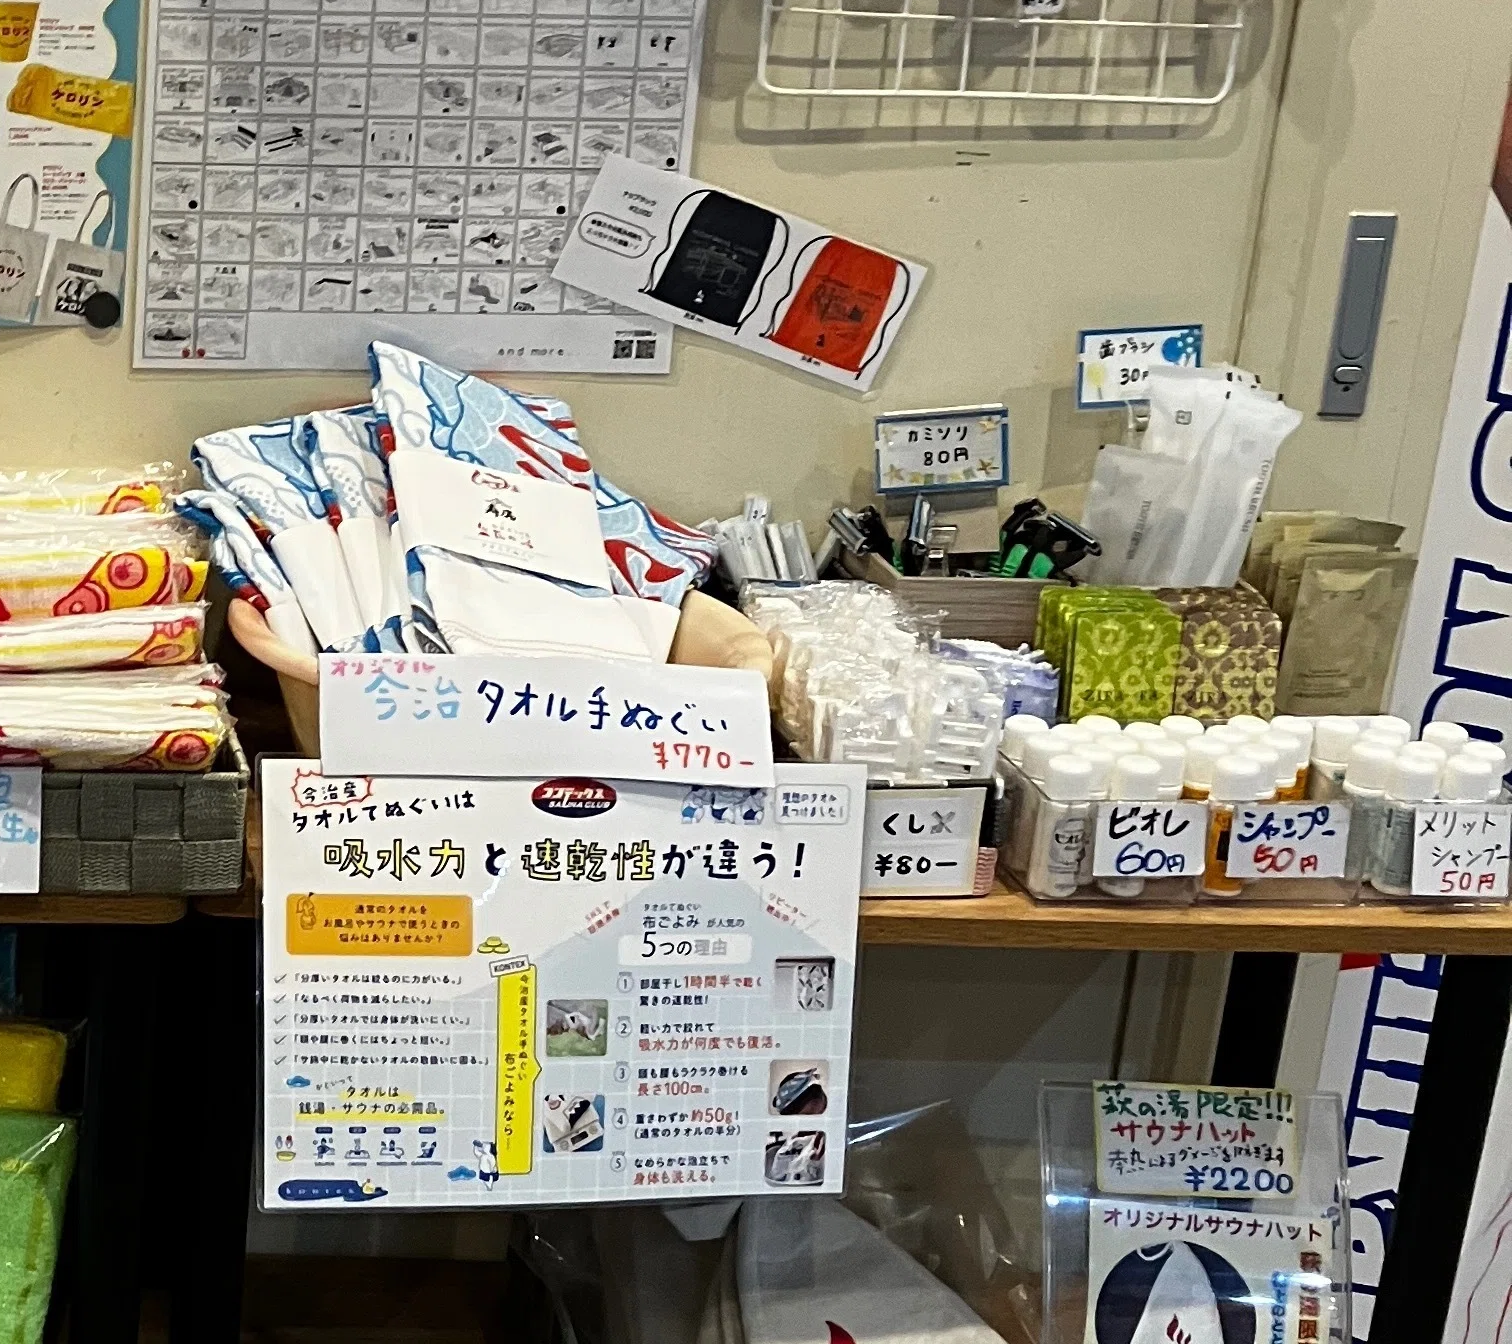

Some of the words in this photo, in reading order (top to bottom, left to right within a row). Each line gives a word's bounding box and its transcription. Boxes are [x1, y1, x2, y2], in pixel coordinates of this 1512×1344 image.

[907, 424, 970, 445] カミソリ
[923, 447, 970, 467] 80円
[329, 659, 437, 676] オリジナル
[364, 672, 462, 724] 今治
[477, 677, 729, 737] タオル手ぬぐい
[301, 780, 361, 804] 今治産
[291, 789, 477, 834] タオルてぬぐいは
[882, 812, 926, 838] くし
[1107, 805, 1191, 840] ビオレ
[1236, 804, 1337, 844] シャンプー
[1419, 810, 1497, 836] メリット
[323, 837, 806, 883] 吸水力と速乾性が違う！
[1115, 844, 1186, 876] 60円
[1252, 843, 1319, 874] 50円
[1431, 844, 1511, 868] シャンプー
[1440, 870, 1496, 894] 50円
[639, 931, 729, 959] 5つの理由
[345, 1085, 400, 1099] タオルは
[1109, 1118, 1256, 1146] サウナハット
[1183, 1164, 1294, 1195] ¥2200
[1102, 1206, 1324, 1243] オリジナルサウナハット
